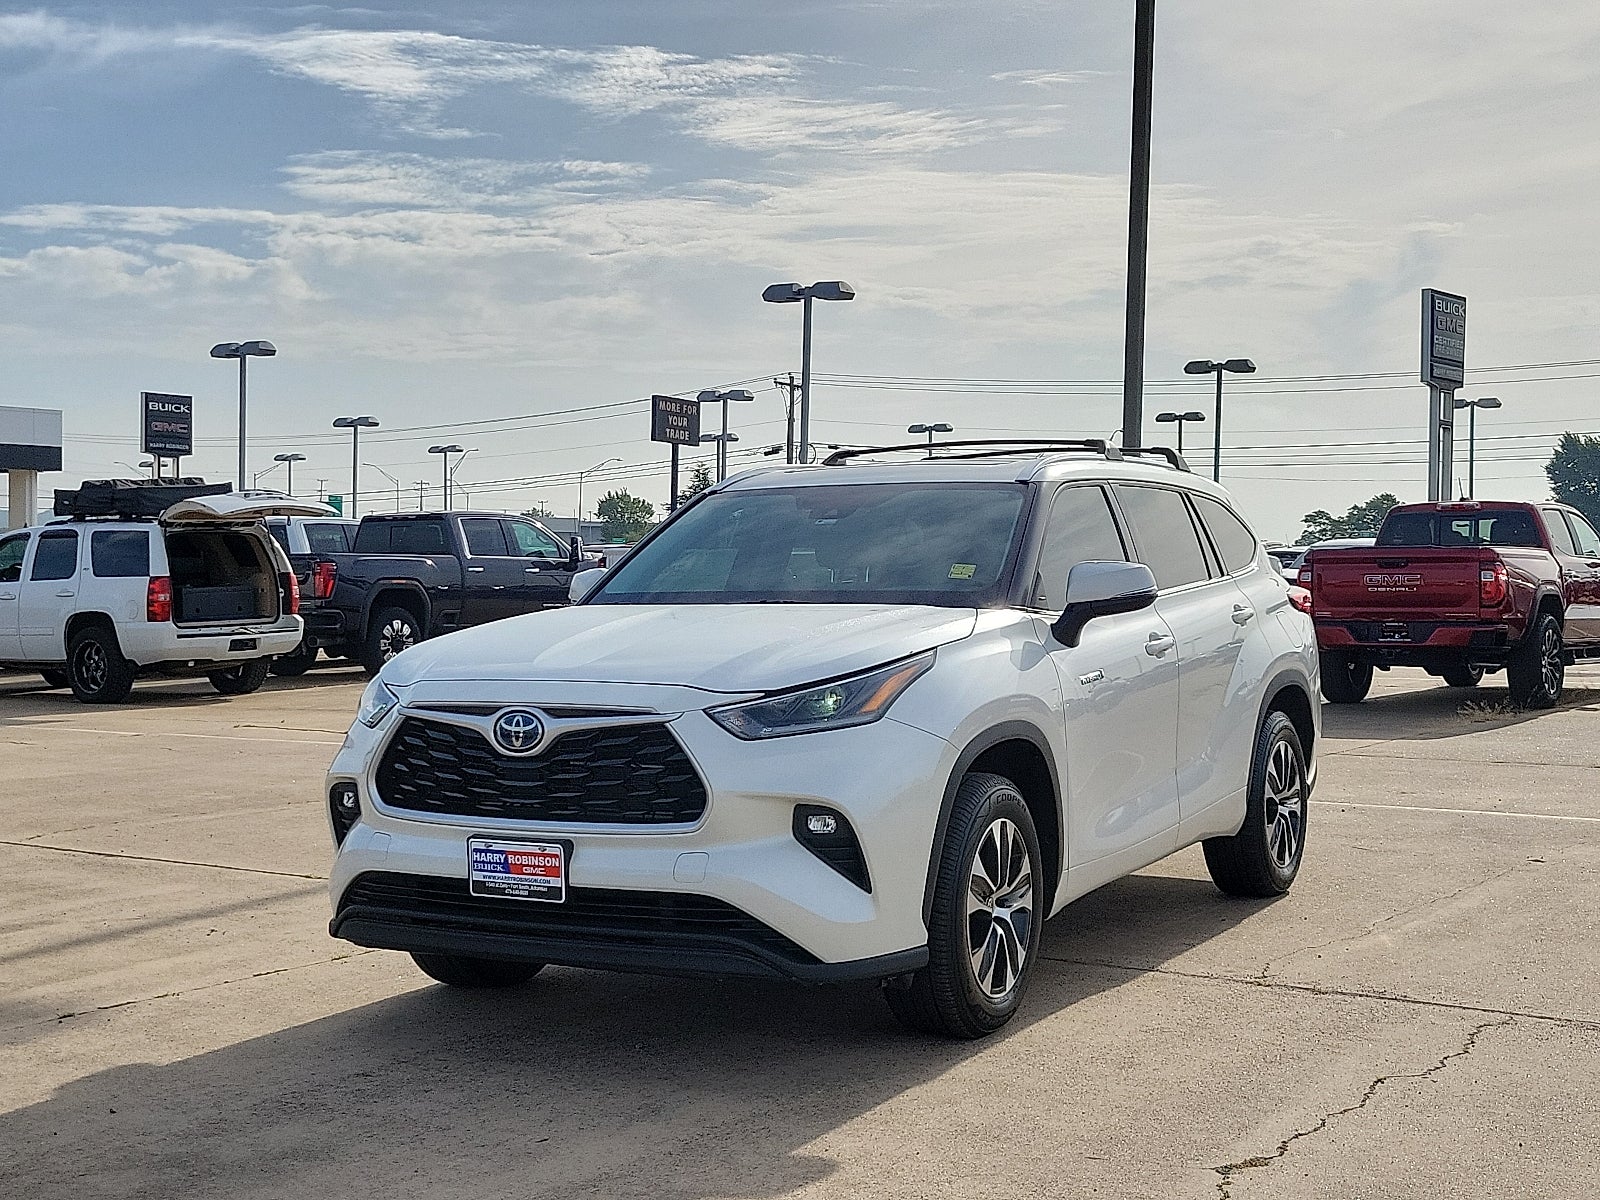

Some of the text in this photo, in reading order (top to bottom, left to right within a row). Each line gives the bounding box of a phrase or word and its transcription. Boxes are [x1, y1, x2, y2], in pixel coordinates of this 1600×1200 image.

[1435, 299, 1465, 317] BUICK
[1436, 315, 1464, 335] GMC
[149, 402, 190, 413] BUICK
[659, 400, 698, 415] MORE FOR
[151, 421, 188, 433] GMC
[668, 415, 688, 427] YOUR
[665, 428, 690, 440] TRADE
[1363, 574, 1421, 586] GMC
[473, 851, 560, 867] HARRY ROBINSON
[473, 862, 506, 872] BUICK
[522, 866, 546, 874] GMC
